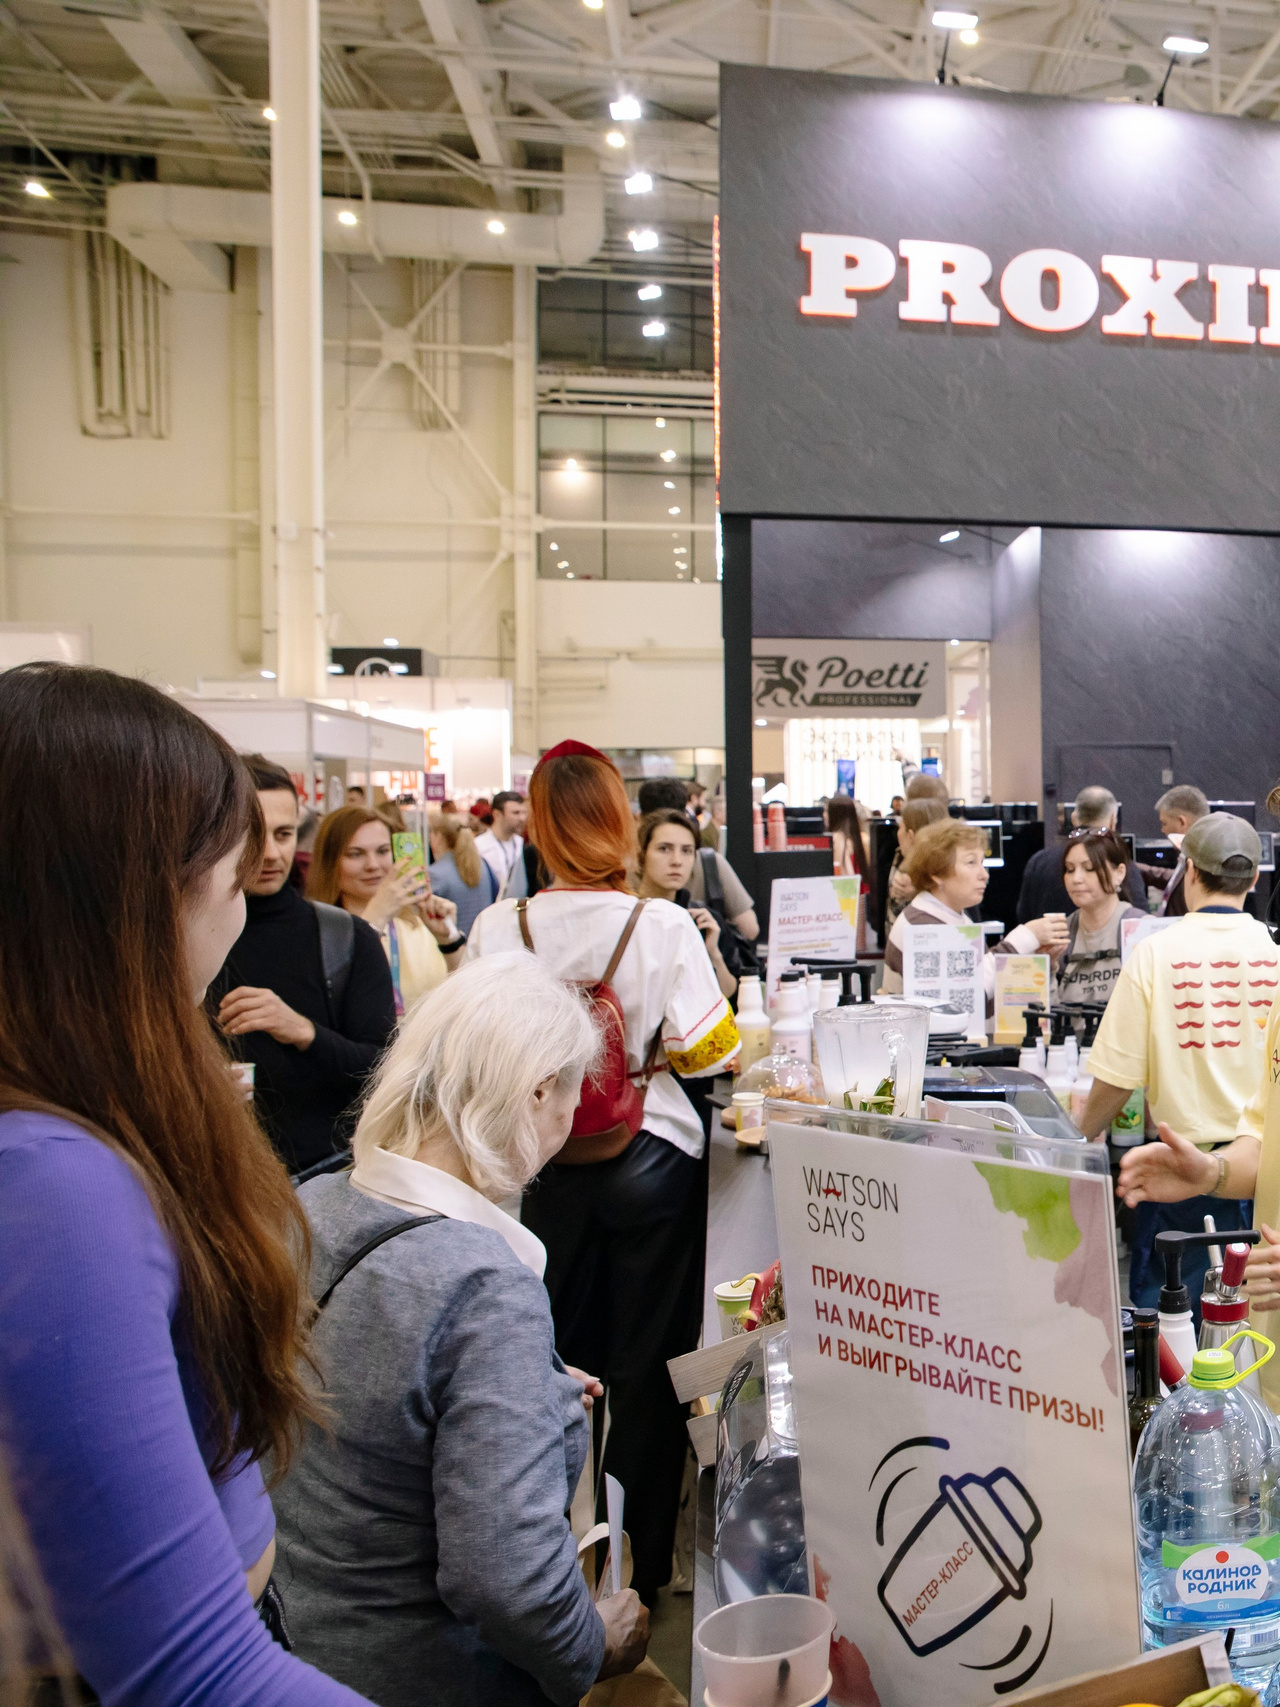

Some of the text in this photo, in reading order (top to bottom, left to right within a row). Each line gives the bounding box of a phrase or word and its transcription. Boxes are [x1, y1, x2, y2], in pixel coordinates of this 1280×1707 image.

[817, 656, 929, 689] Poetti
[802, 1166, 899, 1213] WATSON
[807, 1203, 865, 1242] SAYS
[812, 1265, 941, 1317] ПРИХОДИТЕ
[815, 1299, 1022, 1373] НА МАСТЕР-КЛАСС
[818, 1334, 1104, 1432] И ВЫИГРЫВАЙТЕ ПРИЗЫ!
[902, 1541, 973, 1627] МАСТЕР-КЛАСС
[1187, 1578, 1257, 1595] РОДНИК
